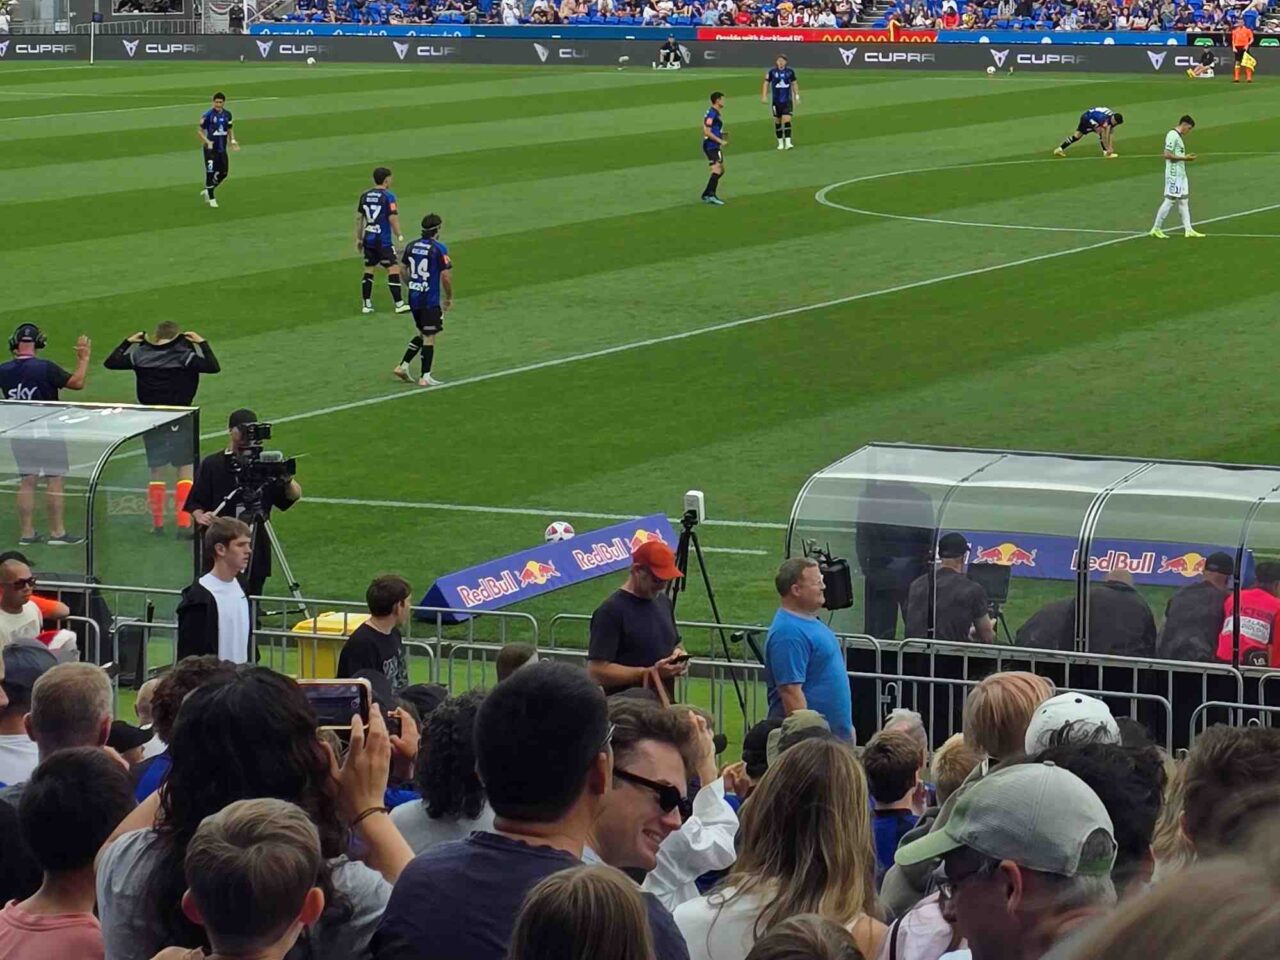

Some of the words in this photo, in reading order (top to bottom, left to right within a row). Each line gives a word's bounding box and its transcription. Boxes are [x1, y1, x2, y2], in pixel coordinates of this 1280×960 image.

[15, 44, 76, 54] CUPRA
[864, 52, 936, 62] CUPRA
[362, 204, 382, 223] 17
[408, 256, 430, 280] 14
[8, 383, 38, 400] sky
